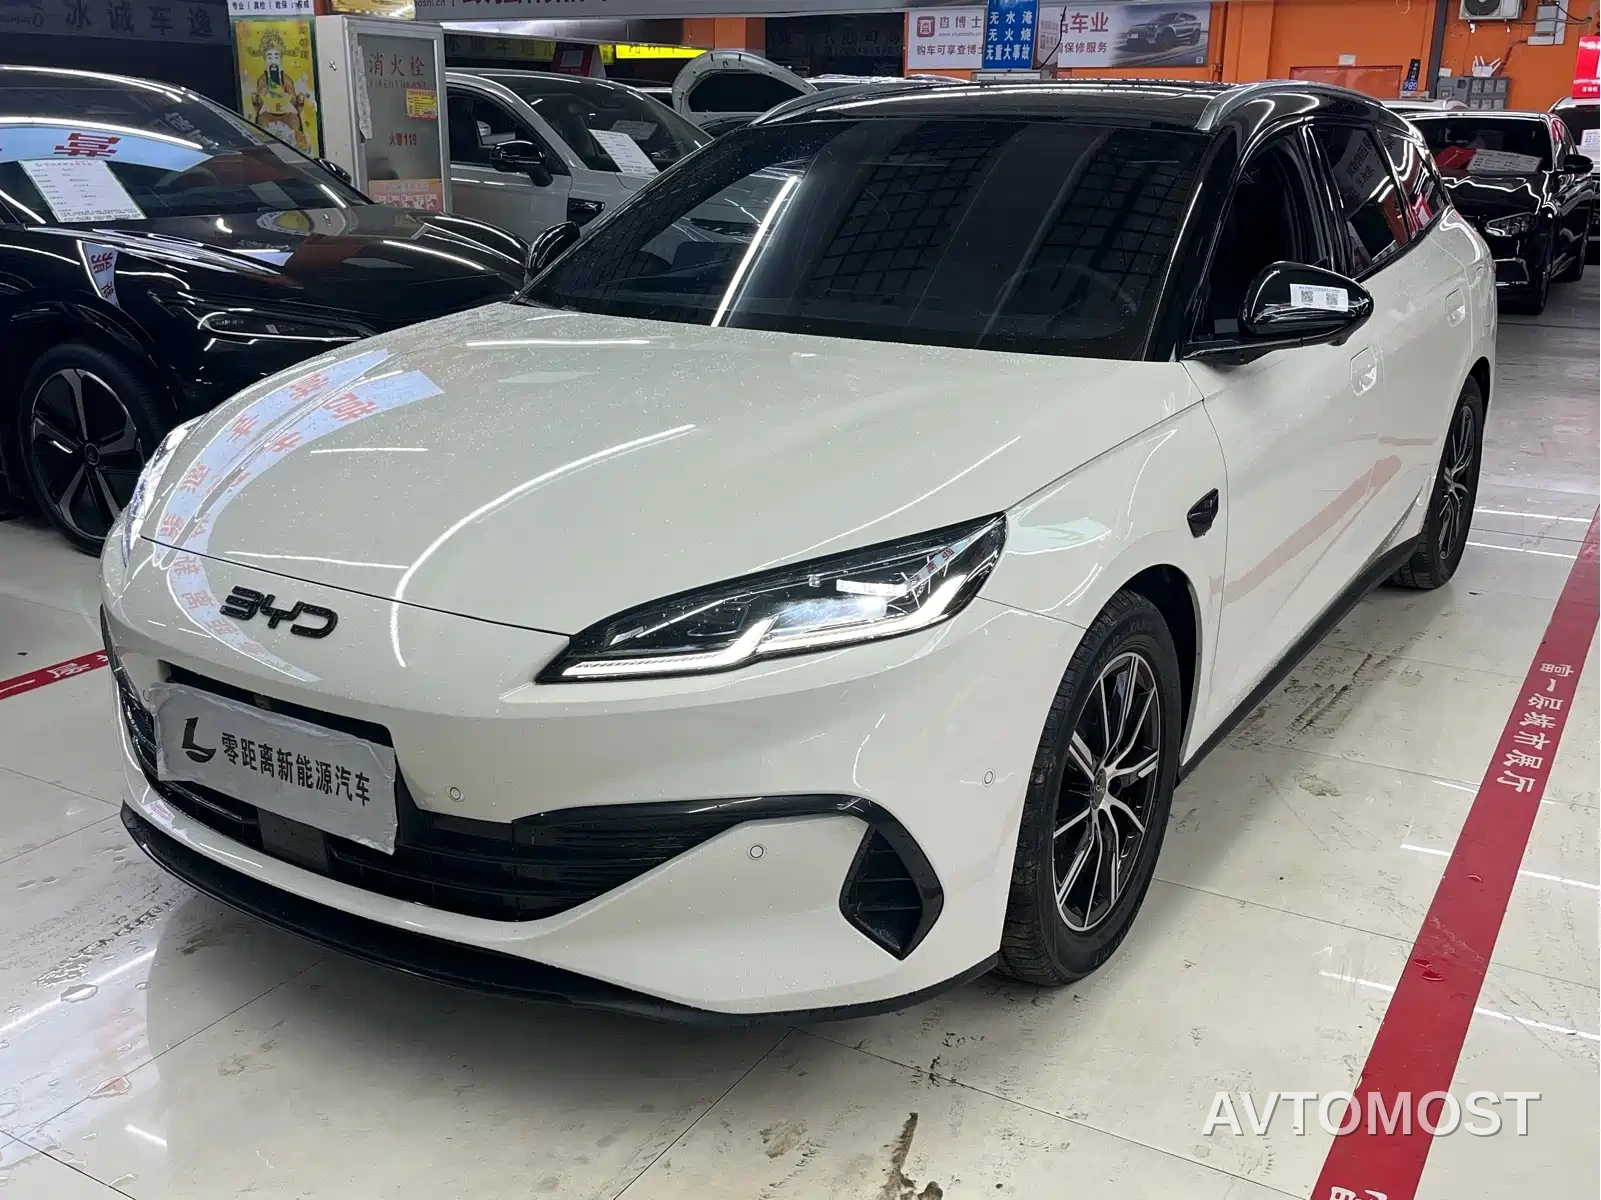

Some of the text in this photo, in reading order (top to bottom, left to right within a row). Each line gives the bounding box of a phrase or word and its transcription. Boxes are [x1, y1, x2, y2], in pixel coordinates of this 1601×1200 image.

[989, 10, 1033, 25] 无水淹
[988, 28, 1031, 41] 无火烧
[985, 44, 1030, 61] 无重大事故
[1058, 42, 1108, 54] 保修服务
[368, 52, 427, 77] 消火栓
[219, 585, 339, 639] BYD
[1496, 662, 1575, 793] 富一层城市展厅
[221, 732, 371, 806] 零距离新能源汽车
